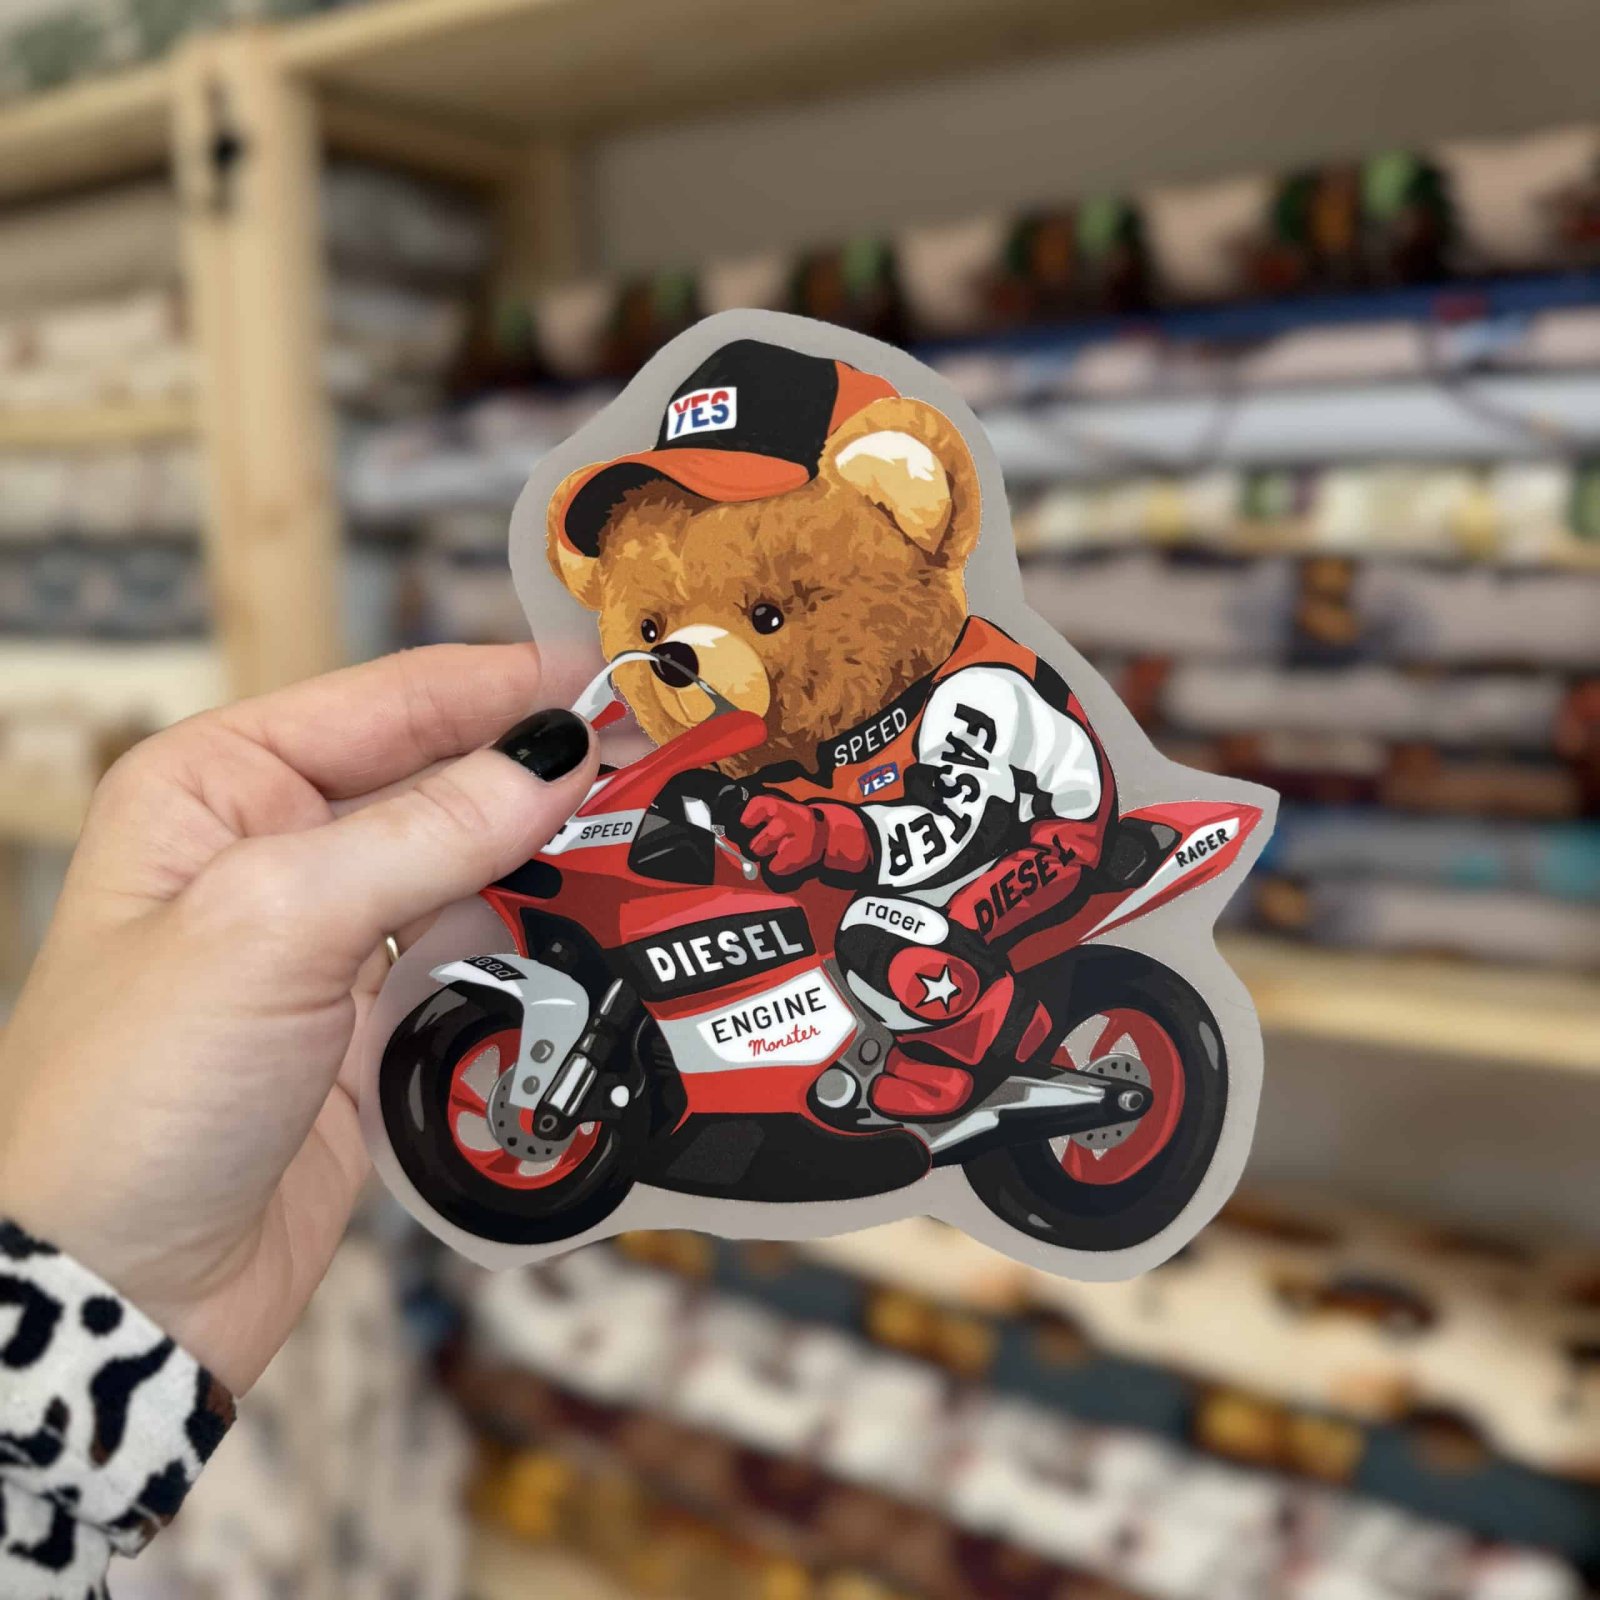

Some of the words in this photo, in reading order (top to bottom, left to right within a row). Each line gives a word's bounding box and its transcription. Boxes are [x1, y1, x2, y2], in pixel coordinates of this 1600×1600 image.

[673, 390, 729, 434] YES
[834, 707, 907, 767] SPEED
[861, 766, 896, 796] YES
[888, 703, 998, 876] FASTER
[580, 821, 633, 840] SPEED
[1175, 828, 1230, 867] RACER
[974, 834, 1076, 937] DIESEL
[865, 901, 925, 934] racer
[466, 957, 519, 978] eed
[646, 920, 804, 982] DIESEL
[711, 987, 826, 1043] ENGINE
[748, 1024, 821, 1056] Monster
